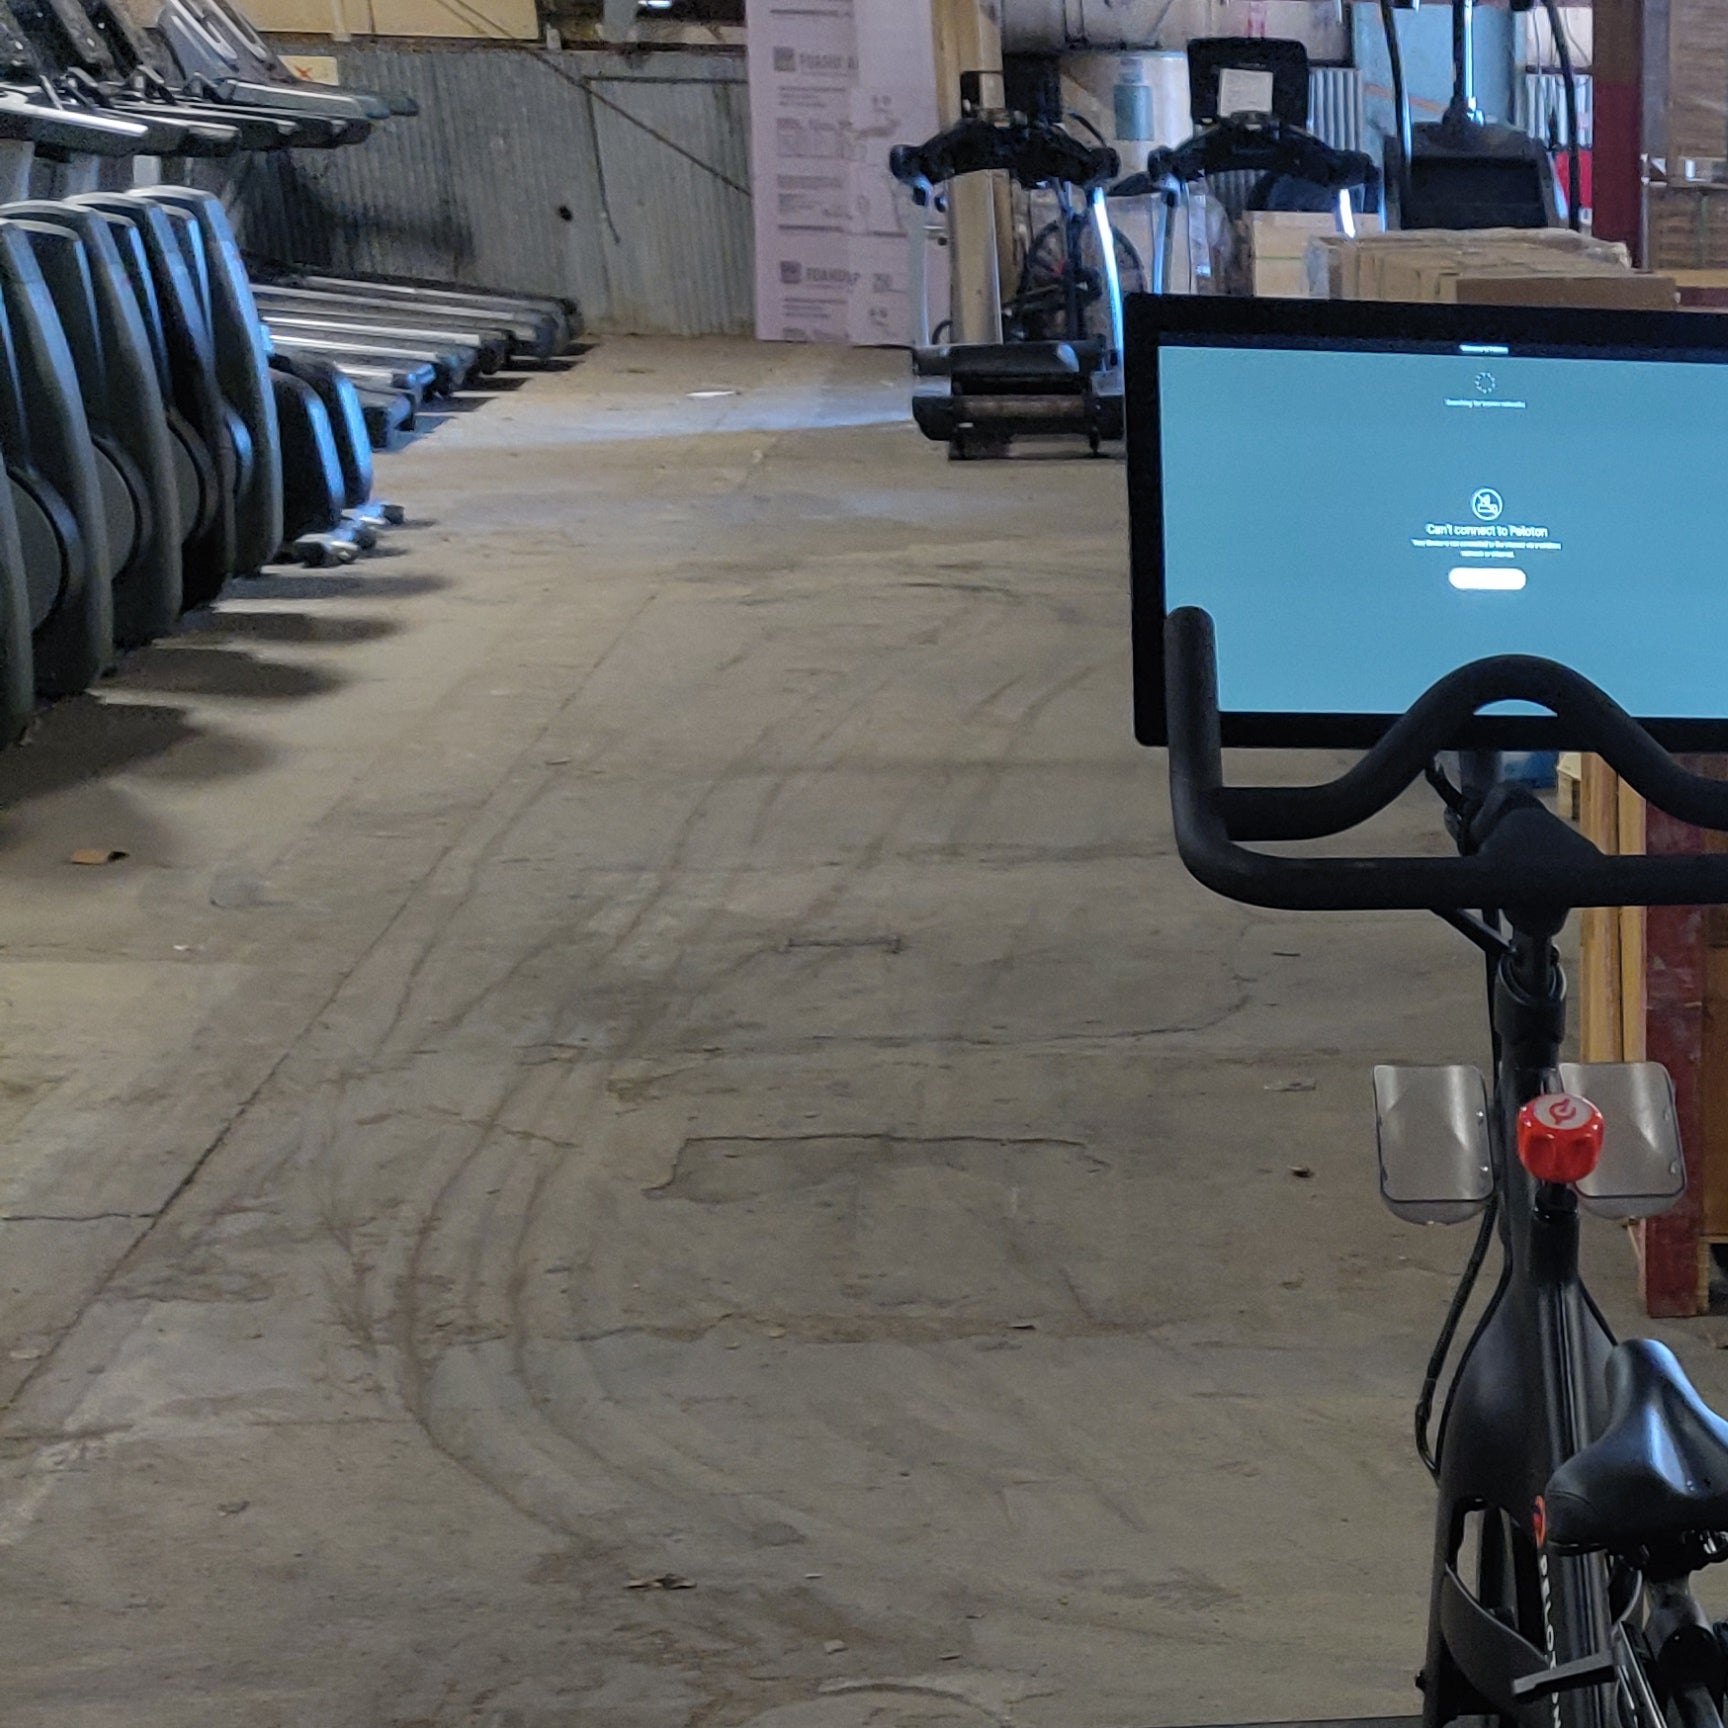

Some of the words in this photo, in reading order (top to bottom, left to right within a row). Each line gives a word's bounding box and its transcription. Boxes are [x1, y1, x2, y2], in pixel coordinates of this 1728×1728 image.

[1454, 525, 1496, 537] connect
[1496, 525, 1509, 537] to
[1509, 525, 1549, 538] Peloton
